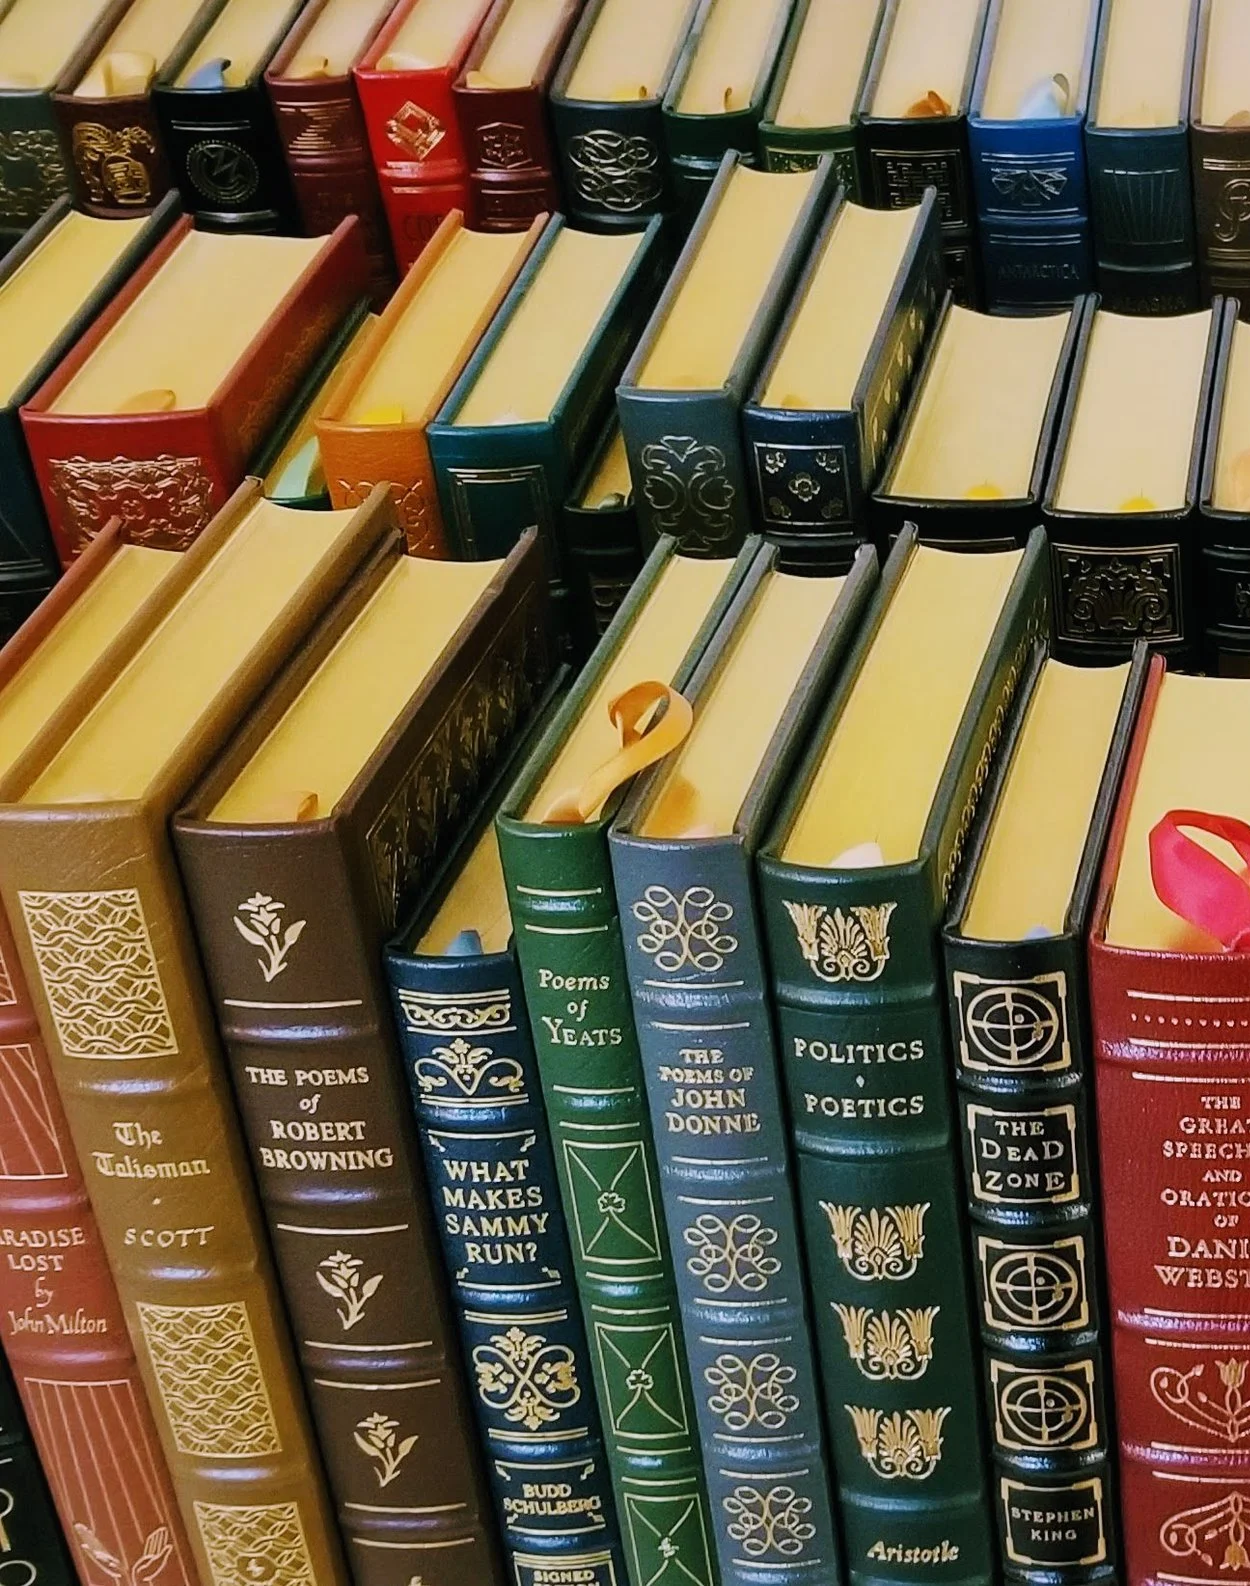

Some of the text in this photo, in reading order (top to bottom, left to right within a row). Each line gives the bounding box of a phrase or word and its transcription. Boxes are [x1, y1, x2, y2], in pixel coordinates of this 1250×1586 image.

[998, 263, 1080, 281] ANTARCTICA
[538, 969, 610, 991] Poems
[567, 1000, 590, 1021] of
[542, 1016, 623, 1046] YEATS
[679, 1048, 724, 1065] THE
[793, 1037, 924, 1064] POLITICS
[245, 1066, 370, 1087] THE POEMS
[658, 1066, 754, 1083] POEMS OF
[299, 1094, 320, 1114] of
[671, 1088, 746, 1109] JOHN
[804, 1093, 924, 1118] POETICS
[1200, 1095, 1242, 1110] THE
[270, 1120, 366, 1142] ROBERT
[665, 1111, 761, 1136] DONNE
[995, 1120, 1045, 1137] THE
[112, 1122, 163, 1150] The
[92, 1150, 211, 1179] Talisman
[259, 1147, 394, 1171] BROWNING
[442, 1158, 530, 1184] WHAT
[984, 1170, 1065, 1192] ZONE
[1202, 1169, 1243, 1183] AND
[442, 1185, 543, 1211] MAKES
[444, 1211, 550, 1238] SAMMY
[1213, 1214, 1240, 1228] OF
[124, 1225, 216, 1248] SCOTT
[7, 1253, 64, 1272] LOST
[465, 1242, 537, 1266] RUN?
[34, 1276, 54, 1308] by
[8, 1307, 108, 1336] John Milton
[523, 1482, 573, 1498] BUDD
[503, 1496, 602, 1516] SCHULBERG
[1011, 1506, 1095, 1524] STEPHEN
[1031, 1528, 1077, 1542] KING
[867, 1539, 960, 1563] Aristotle
[533, 1568, 597, 1583] SIGNED
